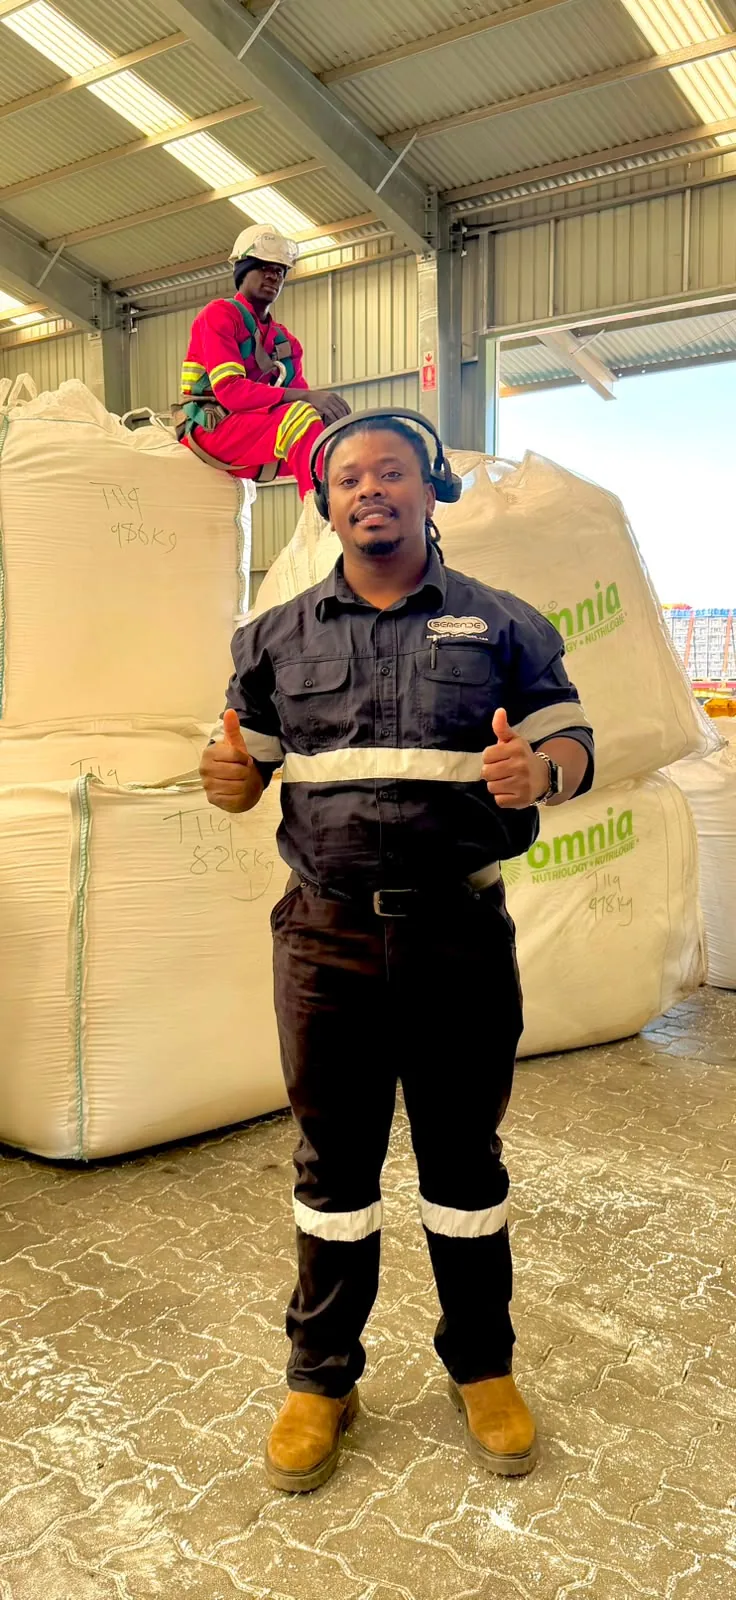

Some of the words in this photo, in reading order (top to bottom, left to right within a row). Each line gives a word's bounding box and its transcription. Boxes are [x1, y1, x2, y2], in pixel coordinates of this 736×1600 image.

[547, 580, 621, 637] mnia
[526, 807, 634, 869] omnia
[532, 862, 588, 885] NUTRIOLOGY
[594, 841, 635, 867] NUTRILOGIE
